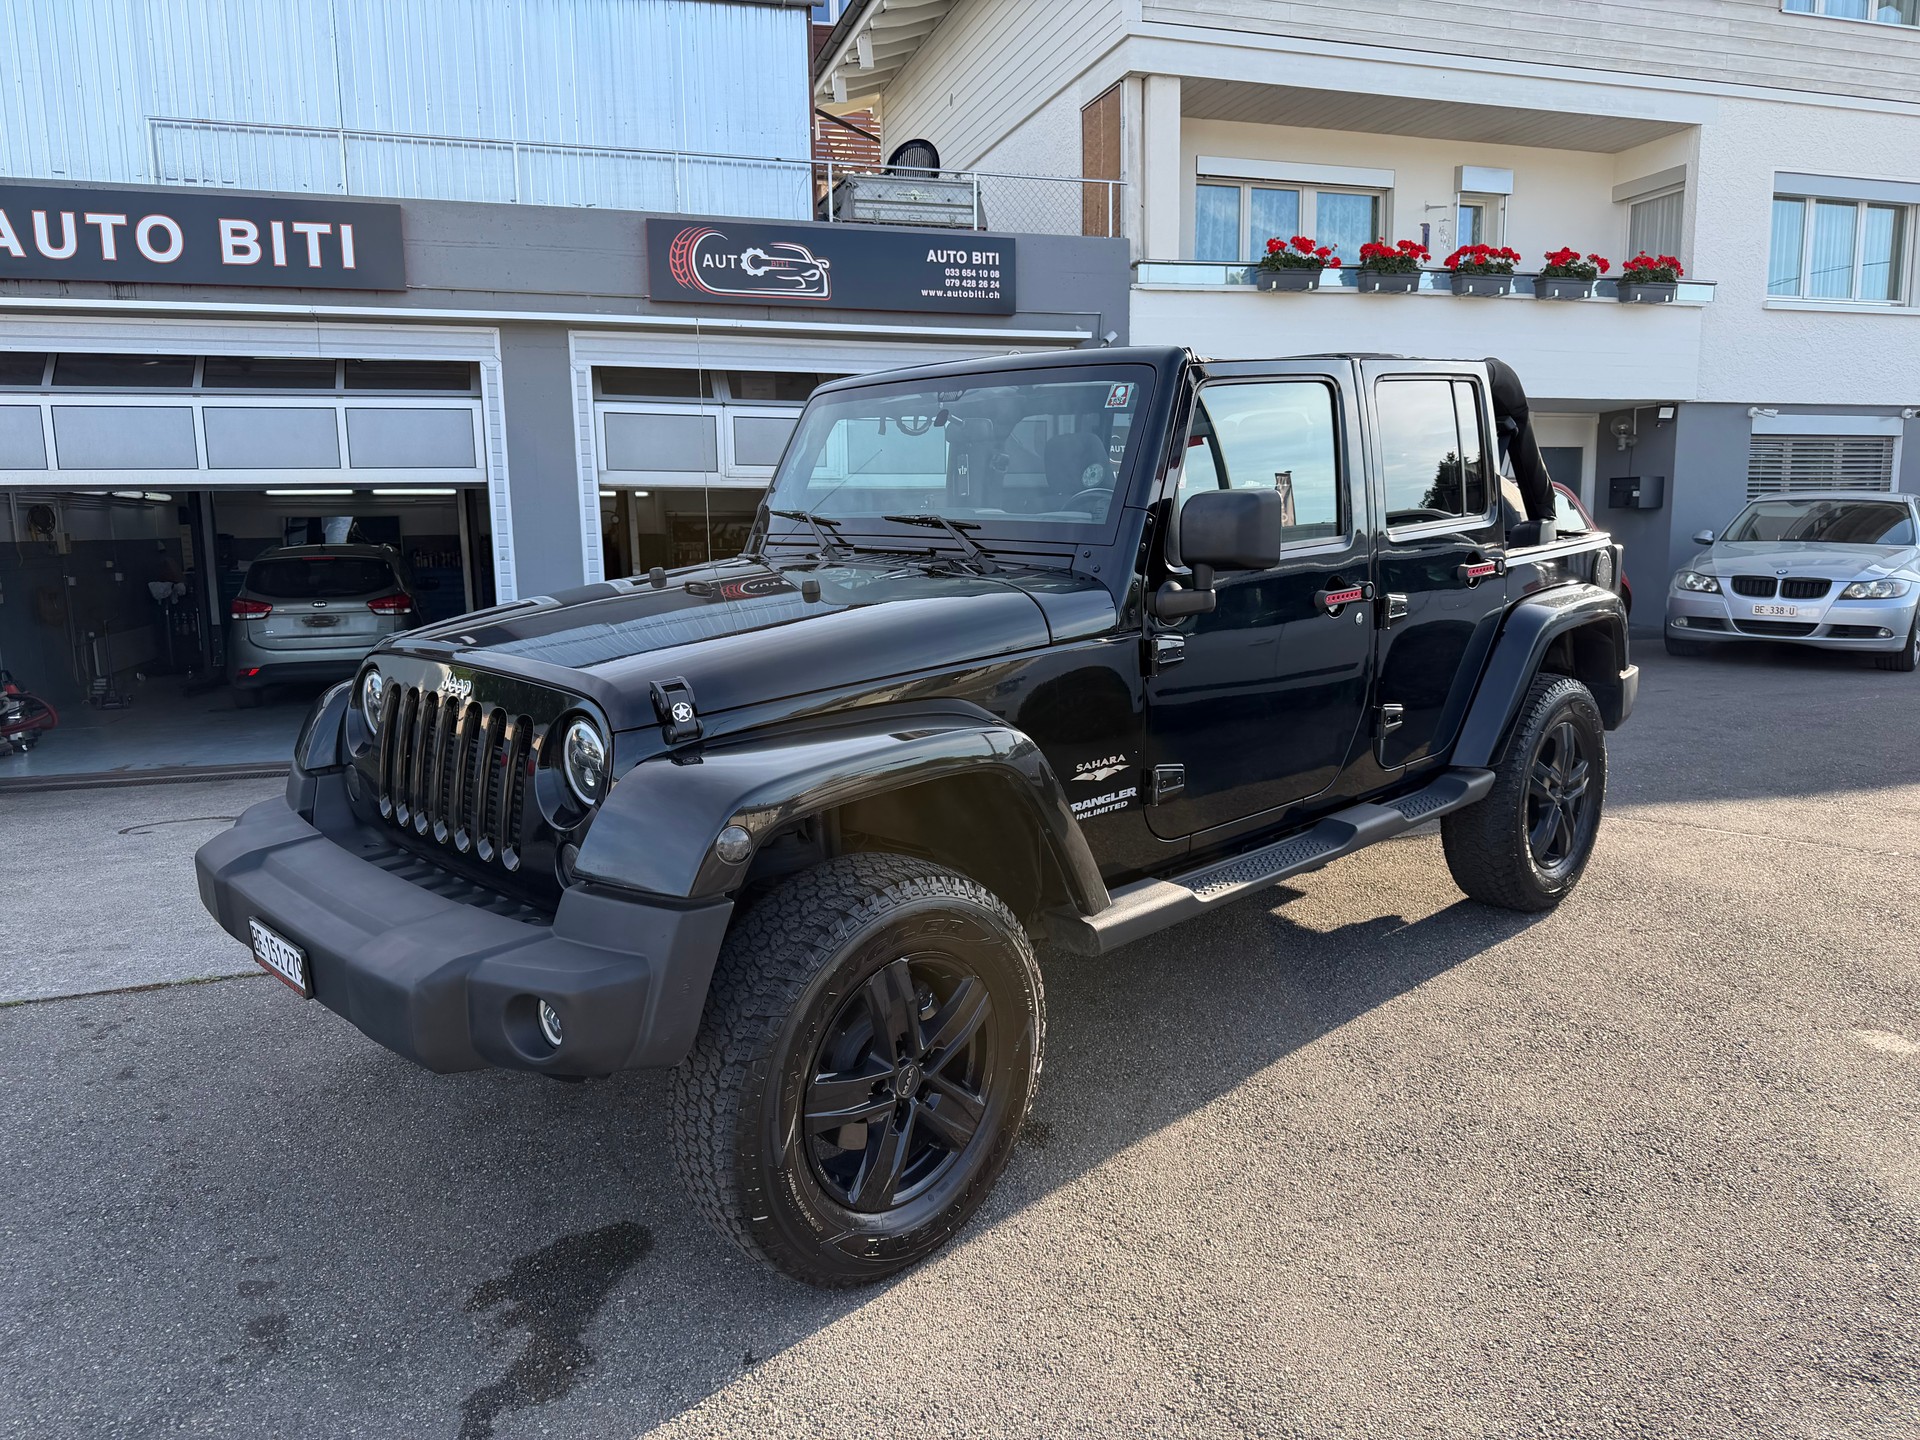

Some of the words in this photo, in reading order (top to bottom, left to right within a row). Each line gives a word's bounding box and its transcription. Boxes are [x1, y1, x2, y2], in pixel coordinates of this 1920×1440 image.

[218, 217, 356, 269] BITI
[770, 260, 790, 268] BITI
[926, 249, 967, 264] AUTO
[972, 251, 1000, 265] BITI
[945, 268, 960, 276] 033
[961, 269, 976, 277] 654
[978, 270, 988, 278] 10
[989, 270, 1000, 278] 08
[945, 278, 960, 287] 079
[962, 279, 976, 288] 428
[921, 289, 1000, 299] www.autobiti.ch
[441, 671, 472, 700] Jeep
[1076, 754, 1126, 772] SAHARA
[1070, 787, 1137, 812] RANGLER
